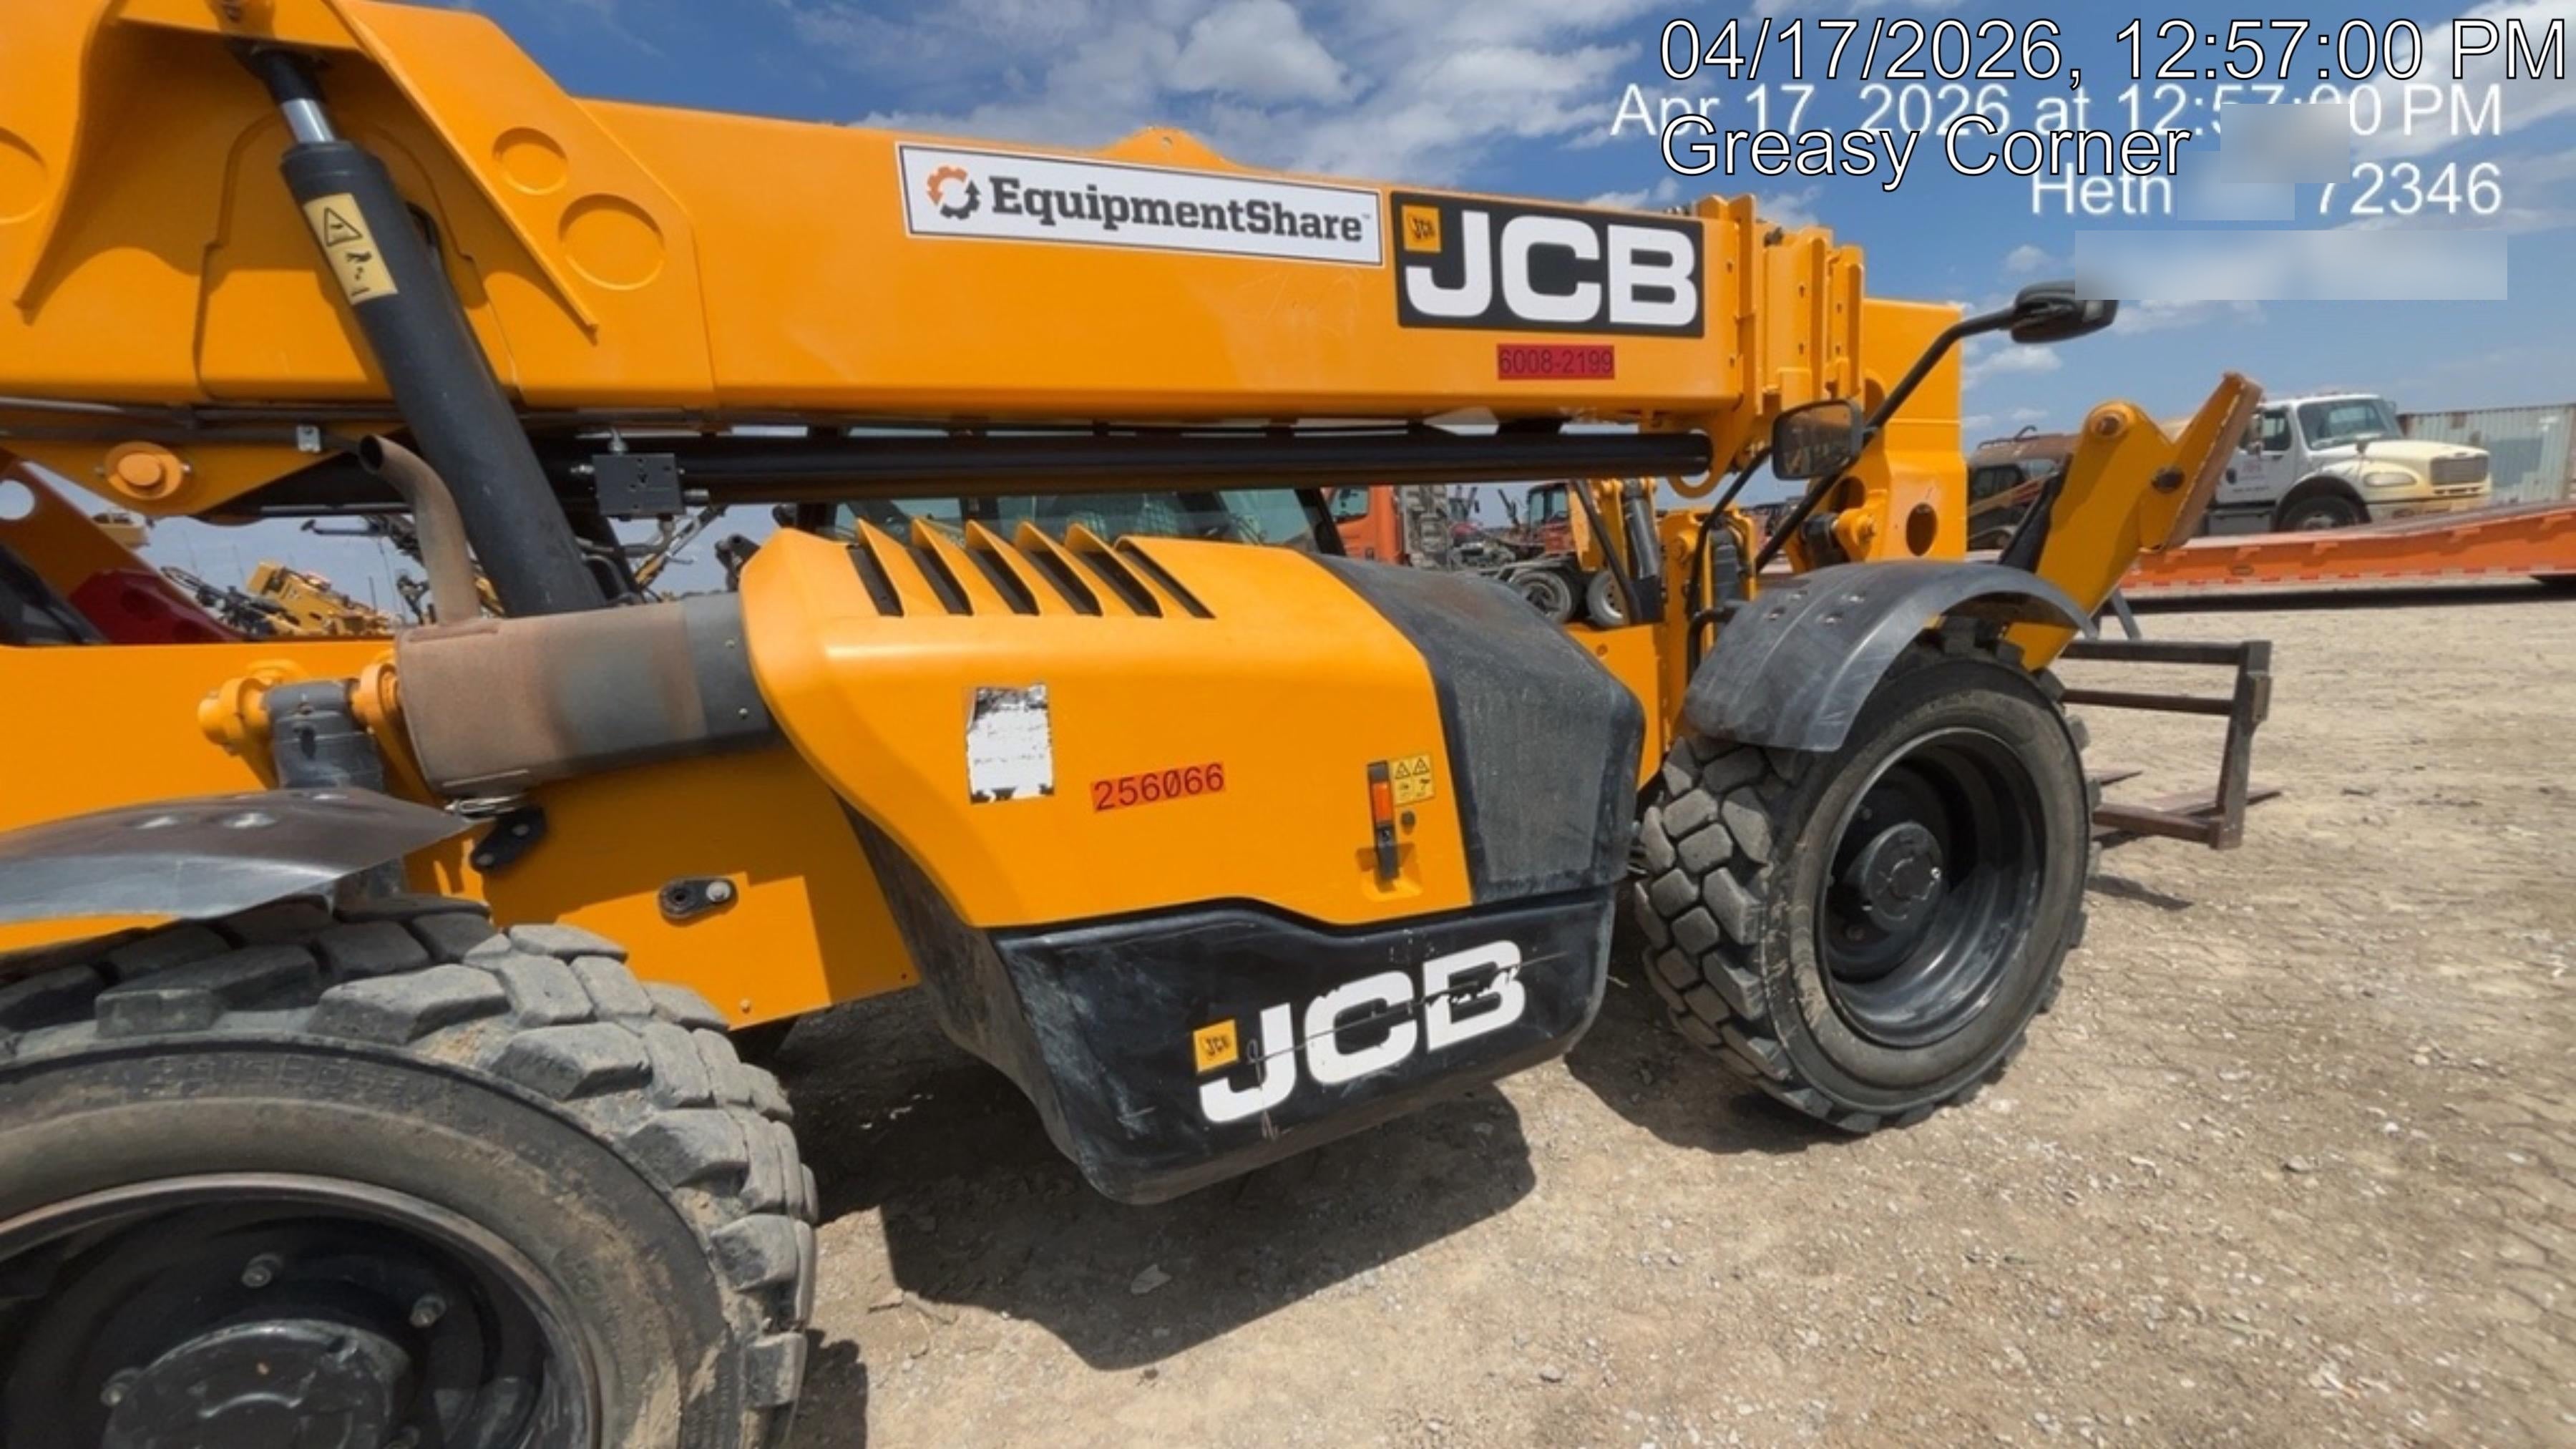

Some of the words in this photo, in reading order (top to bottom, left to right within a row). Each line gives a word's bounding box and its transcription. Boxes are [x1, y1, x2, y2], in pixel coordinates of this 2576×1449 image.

[988, 175, 1363, 243] EquipmentShare
[1405, 210, 1698, 326] JCB
[1500, 348, 1613, 374] 6008-2199
[1094, 763, 1224, 811] 256066
[1199, 940, 1526, 1122] JCB
